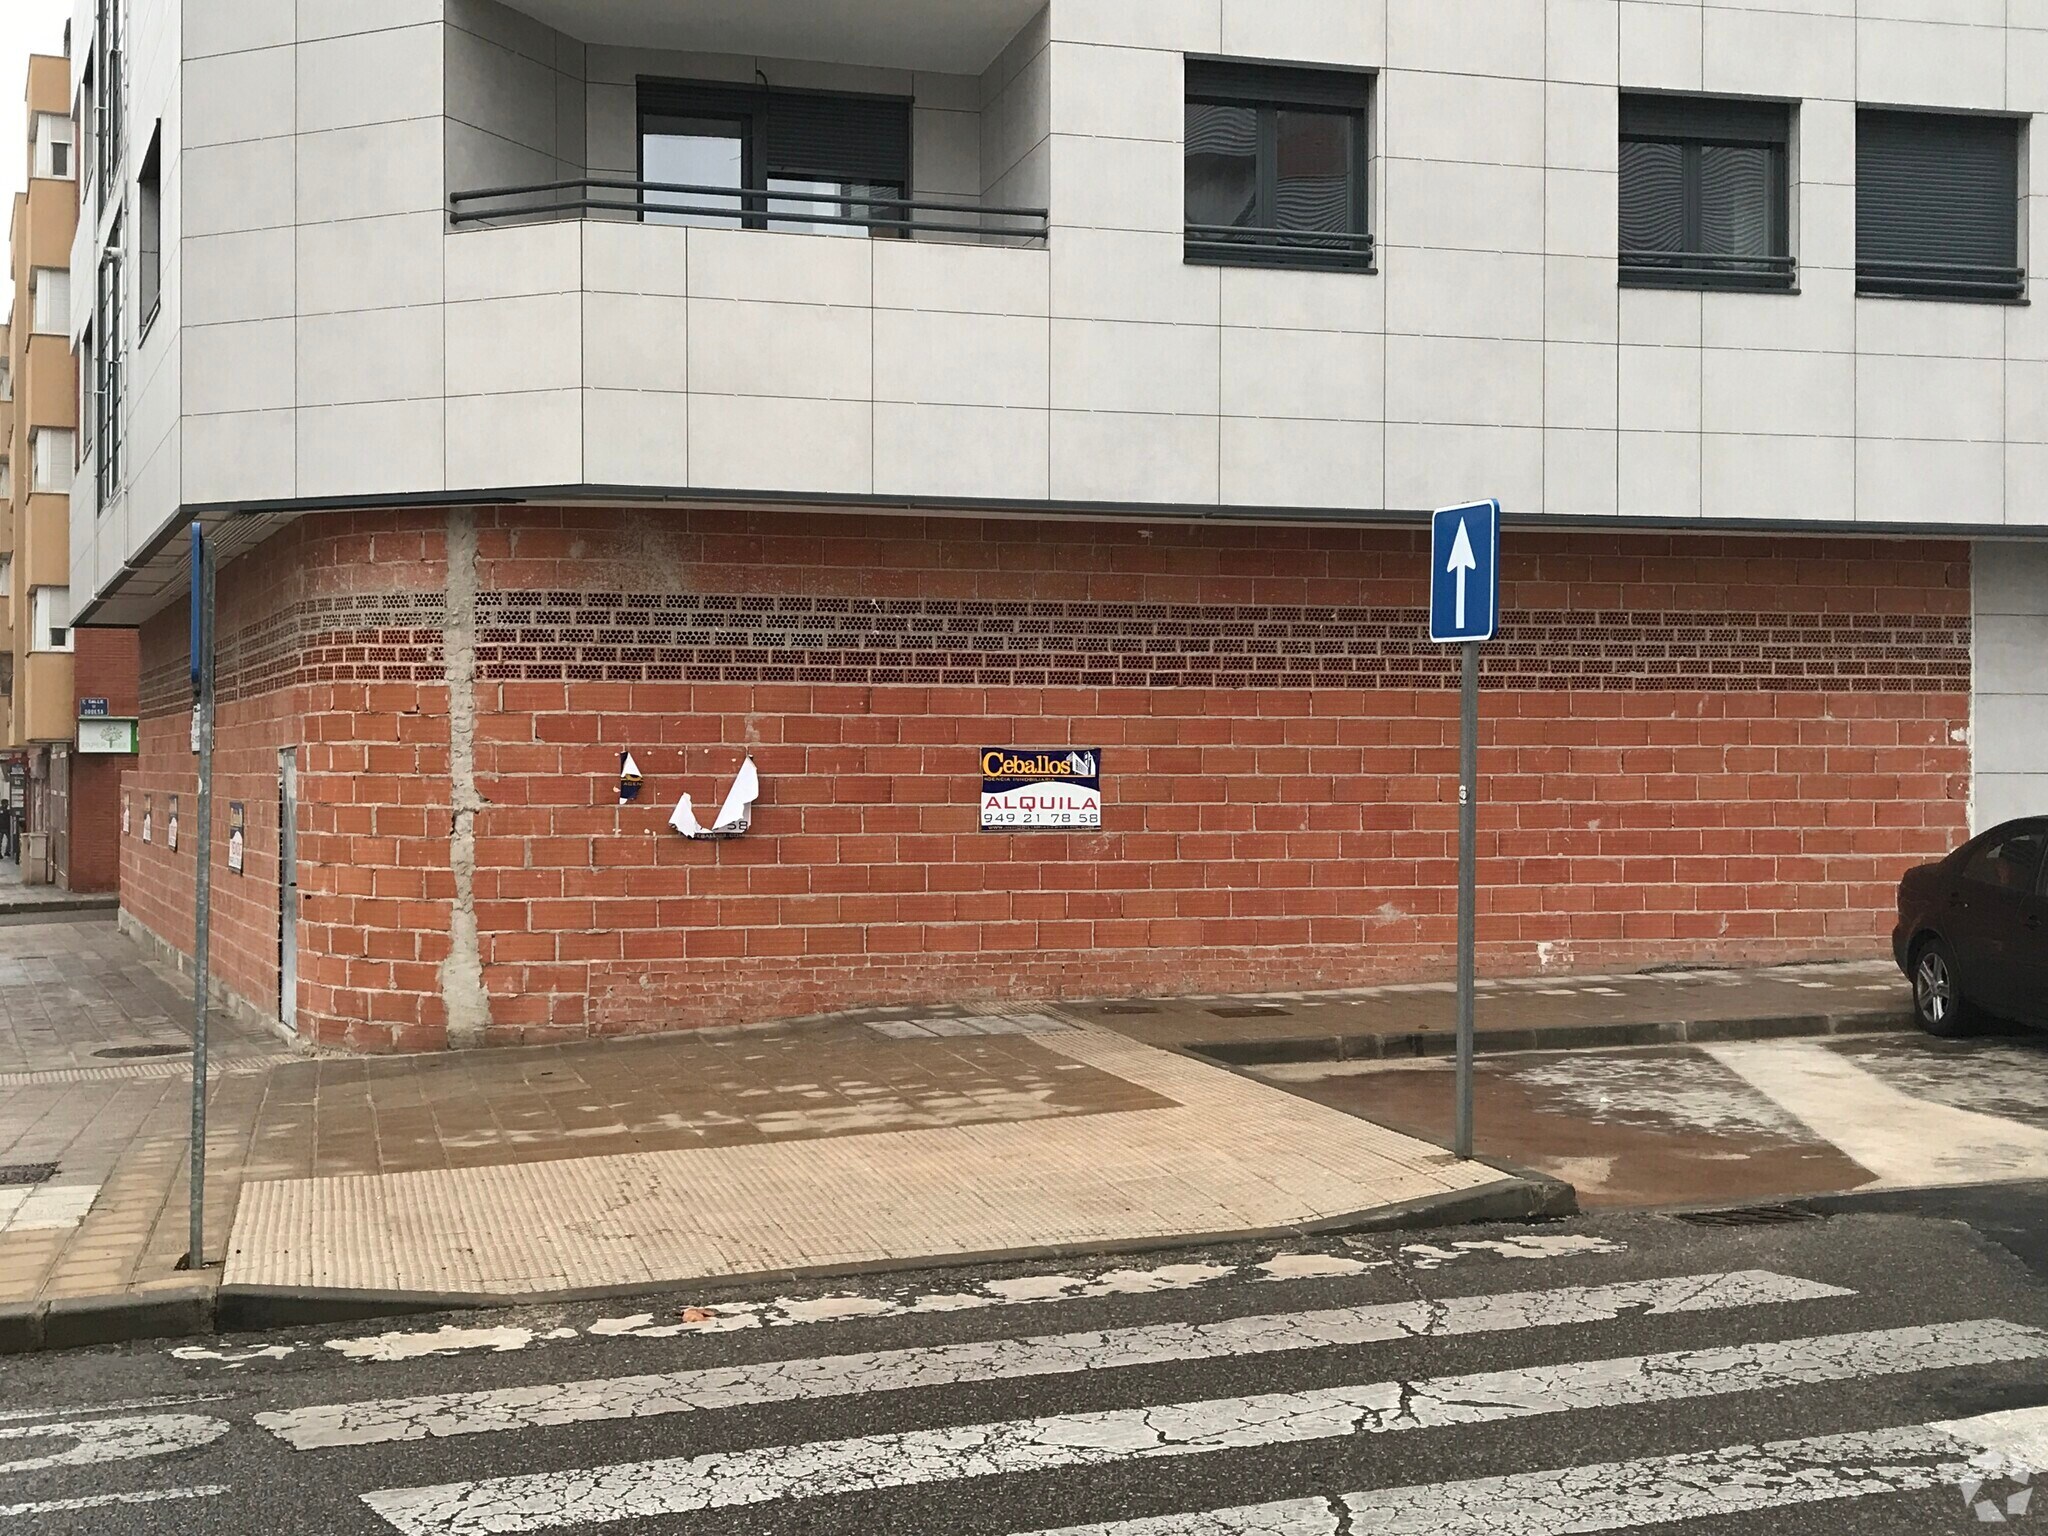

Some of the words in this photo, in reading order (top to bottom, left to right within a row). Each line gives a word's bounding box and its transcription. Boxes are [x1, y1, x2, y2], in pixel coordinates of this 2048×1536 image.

[982, 751, 1071, 777] Ceballos
[985, 796, 1098, 812] ALQUILA
[984, 813, 1016, 823] 949
[1023, 813, 1040, 823] 21
[1051, 813, 1071, 823] 78
[1079, 813, 1099, 823] 58
